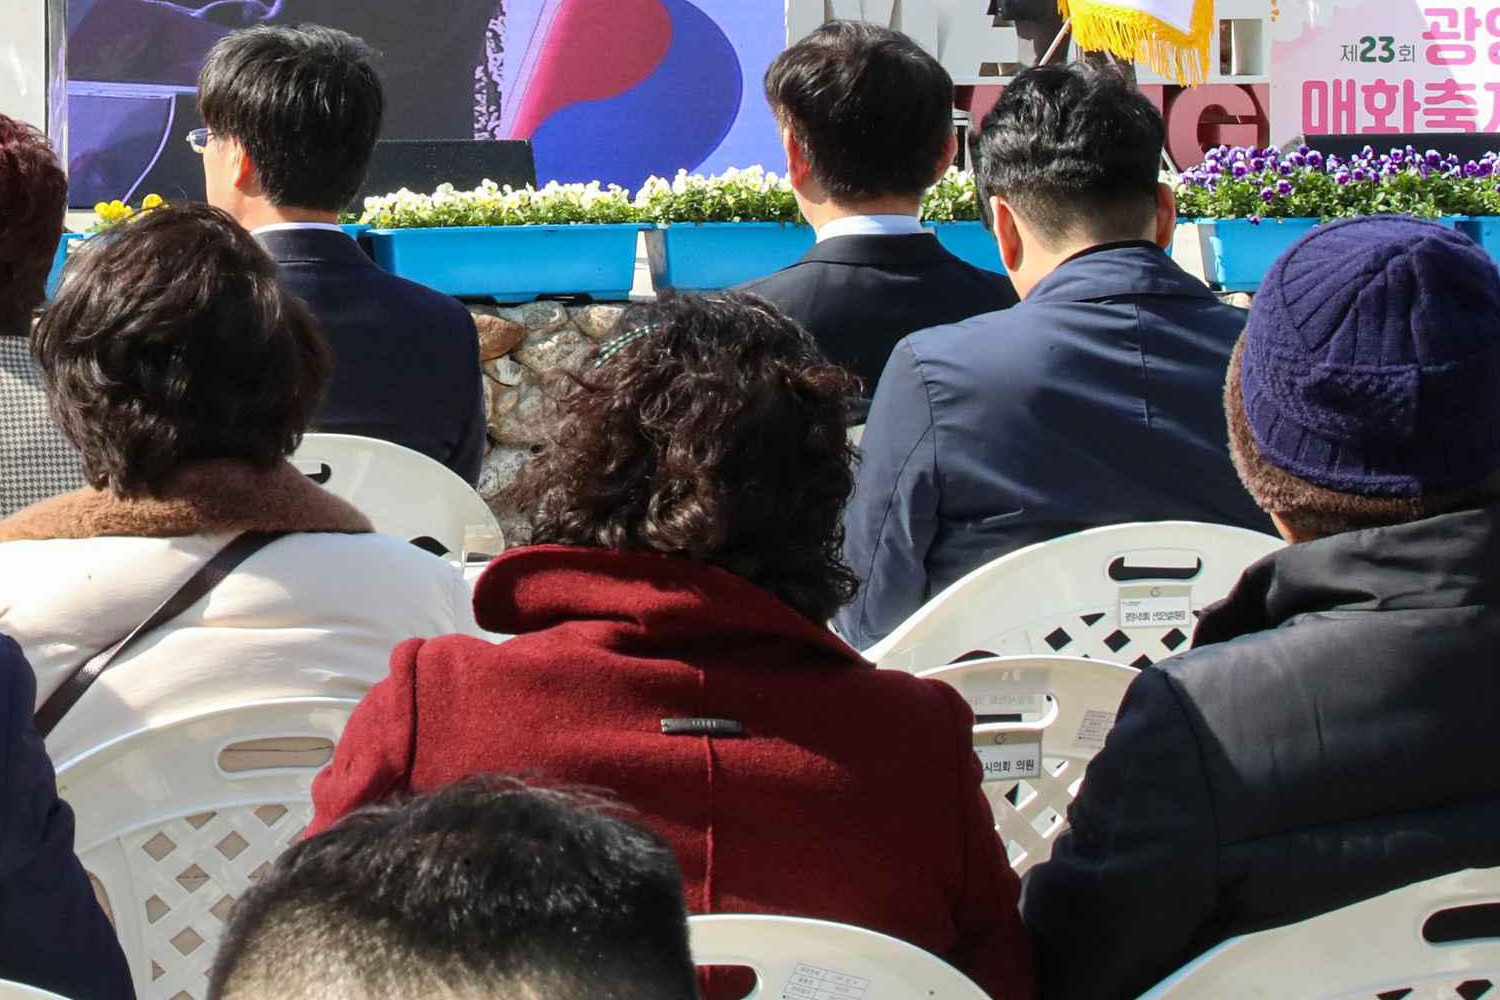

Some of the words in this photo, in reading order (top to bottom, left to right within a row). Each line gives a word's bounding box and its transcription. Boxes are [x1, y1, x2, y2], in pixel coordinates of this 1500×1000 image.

[1340, 36, 1415, 63] 제23회
[983, 760, 1011, 773] 시의회
[1016, 758, 1035, 771] 의원
